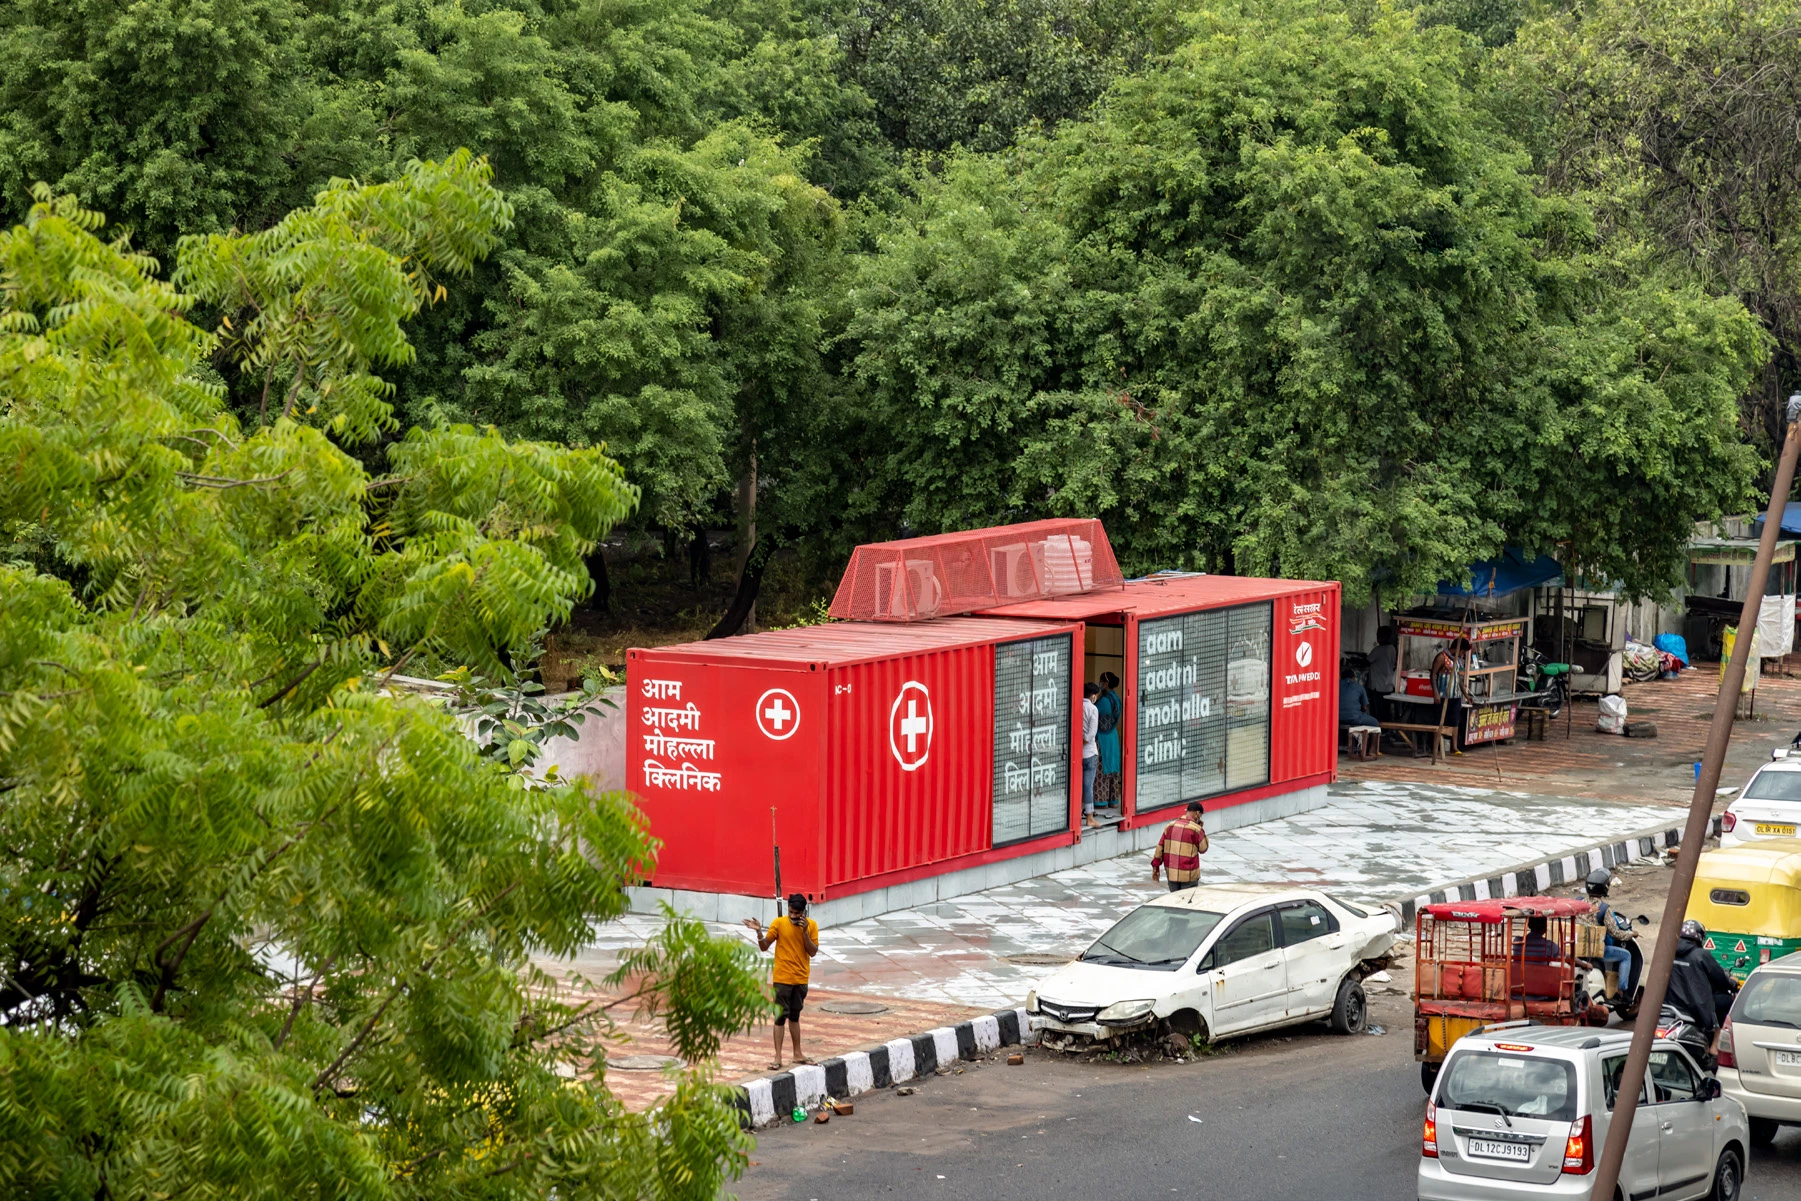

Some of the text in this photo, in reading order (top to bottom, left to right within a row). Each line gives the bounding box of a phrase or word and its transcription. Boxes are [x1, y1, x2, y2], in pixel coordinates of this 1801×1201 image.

[1146, 630, 1182, 655] aam
[1033, 651, 1058, 676] आम
[1145, 655, 1197, 691] aadmi
[641, 679, 682, 701] आम
[1018, 678, 1058, 716] आदमी
[641, 702, 701, 732] आदमी
[1145, 693, 1210, 728] mohalla
[643, 728, 715, 760] मोहल्ला
[1009, 722, 1057, 753] मोहल्ला
[1144, 731, 1187, 765] clinic
[643, 759, 721, 792] क्लिनिक
[1004, 757, 1057, 794] क्लिनिक
[1474, 1142, 1527, 1157] DL12CJ9193
